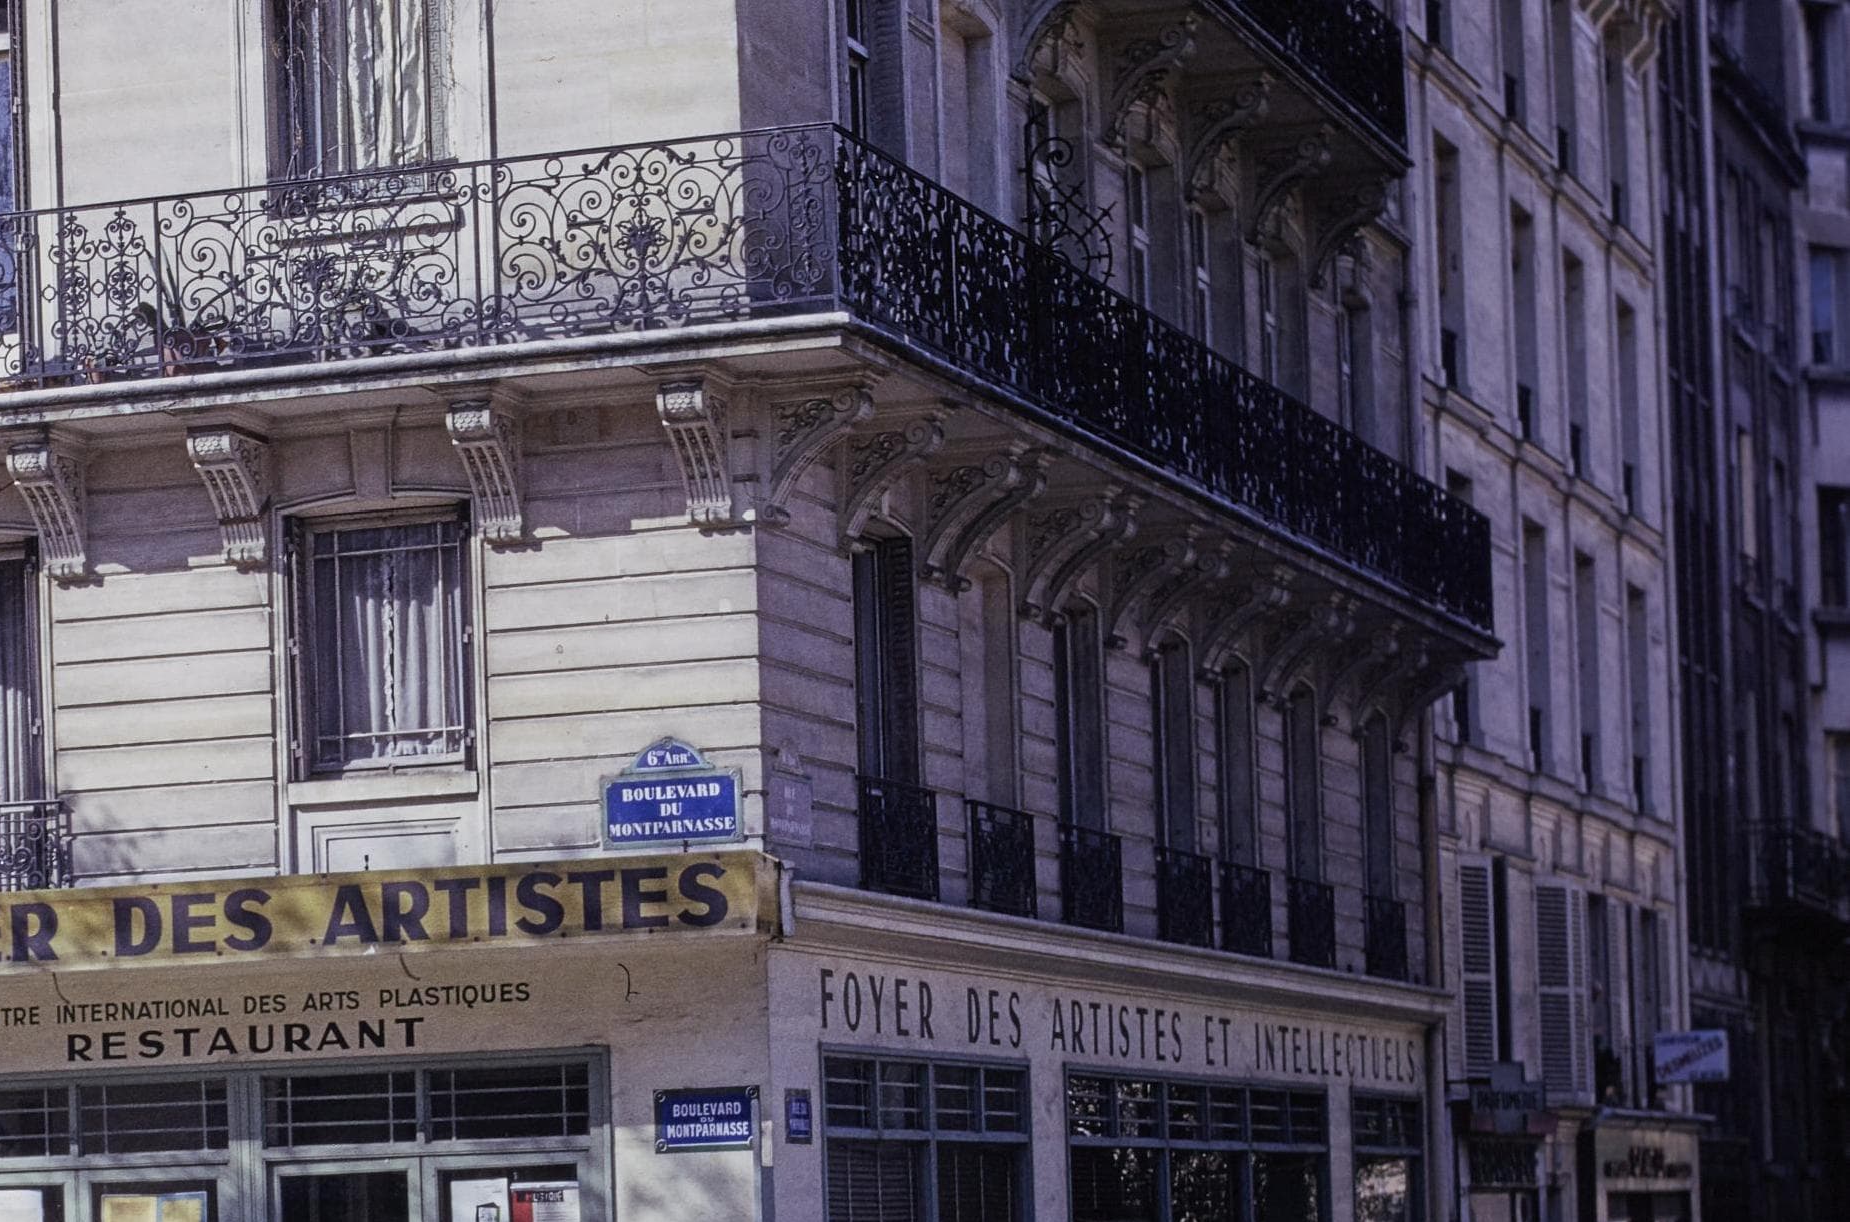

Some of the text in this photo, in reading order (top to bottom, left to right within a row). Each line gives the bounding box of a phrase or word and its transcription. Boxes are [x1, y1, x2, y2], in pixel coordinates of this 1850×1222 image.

[622, 782, 720, 802] BOULEVARD
[660, 802, 682, 817] DU
[609, 816, 736, 838] MONTPARNASSE
[114, 888, 302, 957] DES
[322, 861, 728, 945] ARTISTES
[56, 997, 229, 1024] INTERNATIONAL
[244, 995, 287, 1014] DES
[302, 991, 360, 1012] ARTS
[379, 982, 531, 1009] PLASTIQUES
[820, 968, 1416, 1084] FOYER DES ARTISTES ET INTELLECTUELS
[66, 1016, 424, 1062] RESTAURANT
[672, 1101, 742, 1117] BOULEVARD
[666, 1121, 750, 1139] MONTPARNASSE
